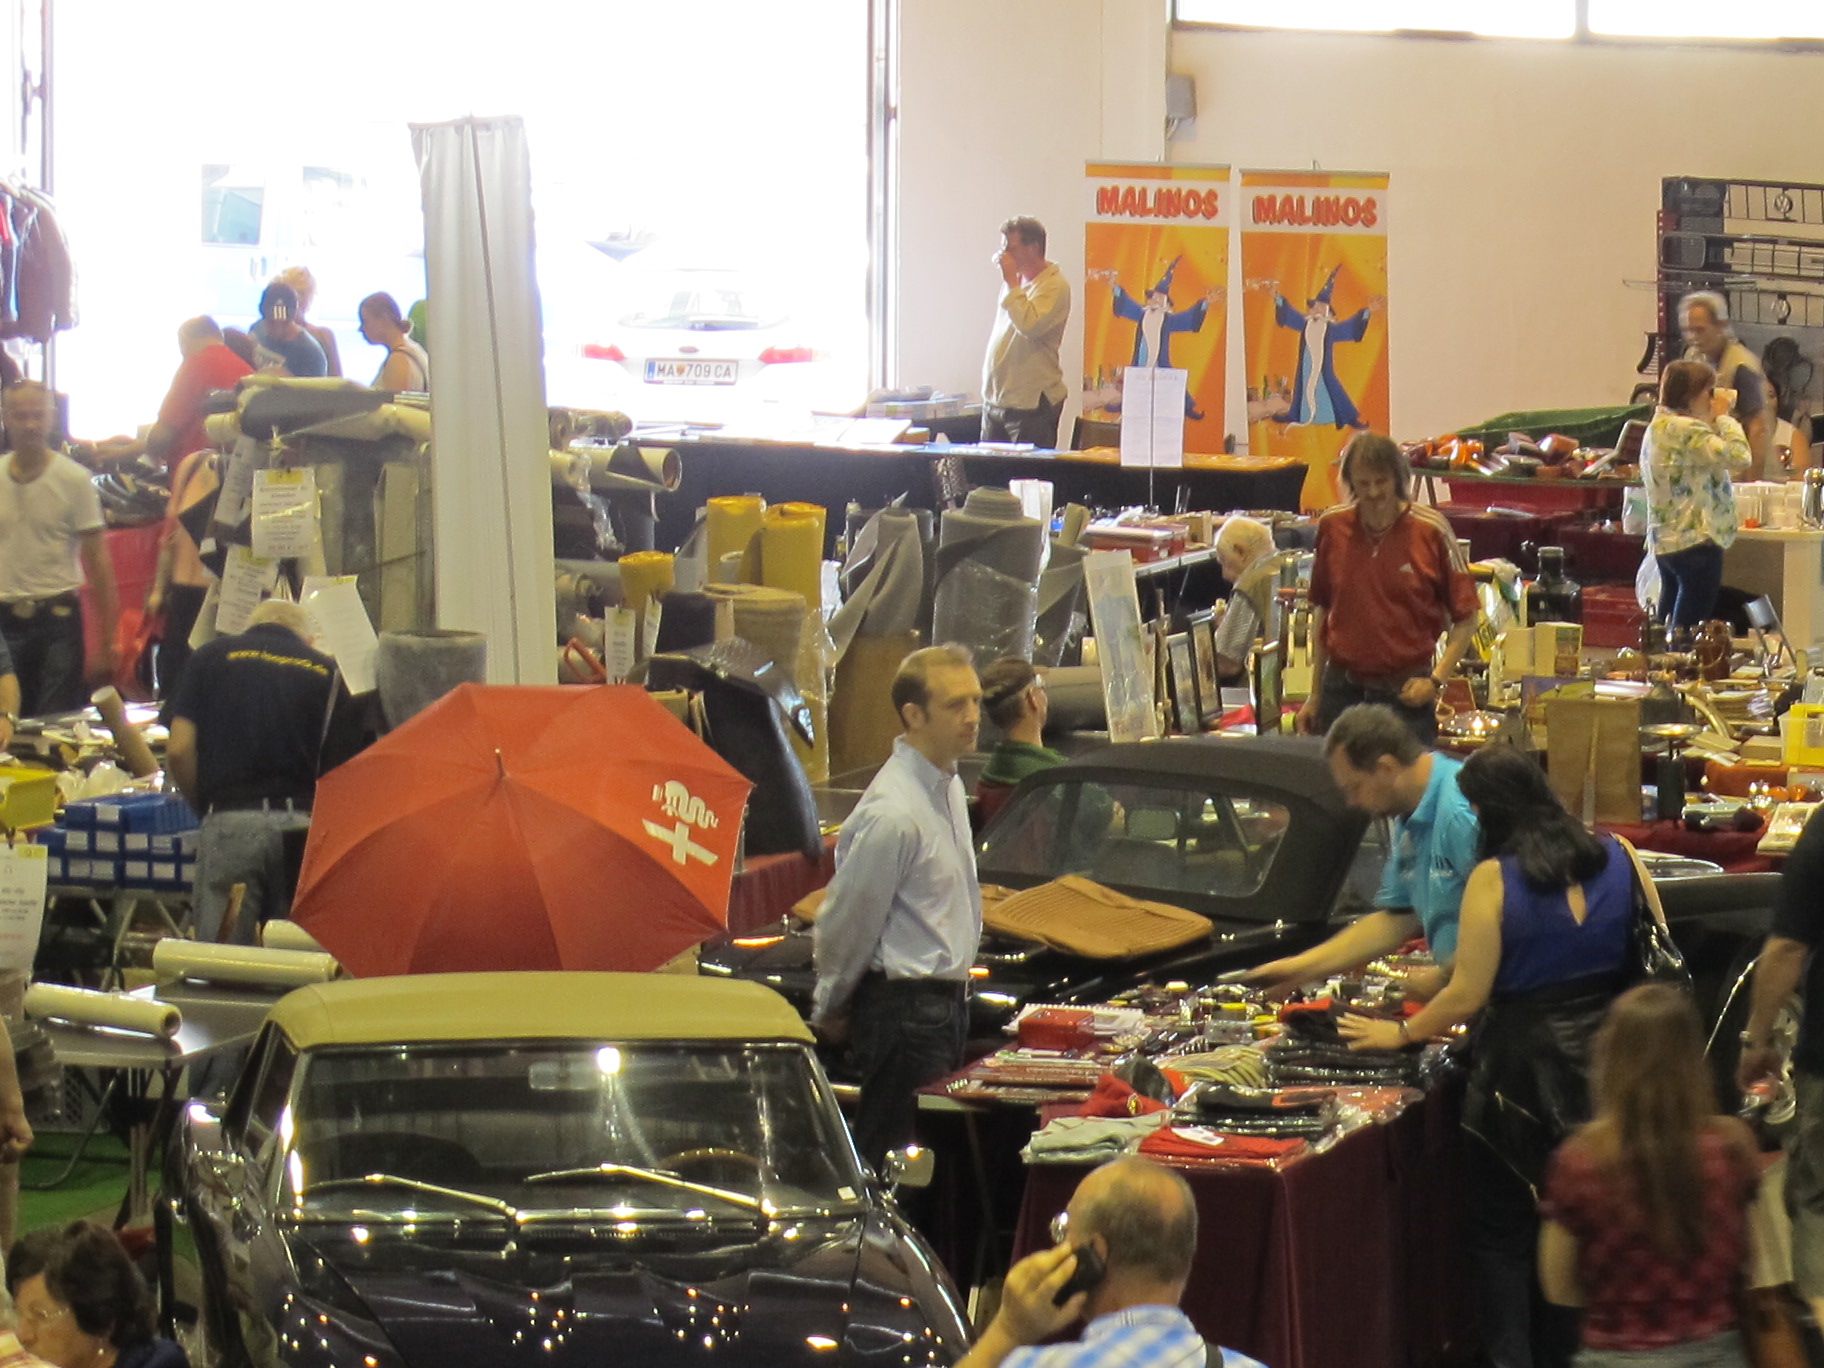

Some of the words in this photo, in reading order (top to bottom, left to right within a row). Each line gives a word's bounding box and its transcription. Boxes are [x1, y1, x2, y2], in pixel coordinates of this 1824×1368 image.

[1096, 185, 1219, 219] MALINOS
[1252, 194, 1378, 228] MALINOS
[686, 364, 712, 378] 709
[714, 364, 732, 379] CA
